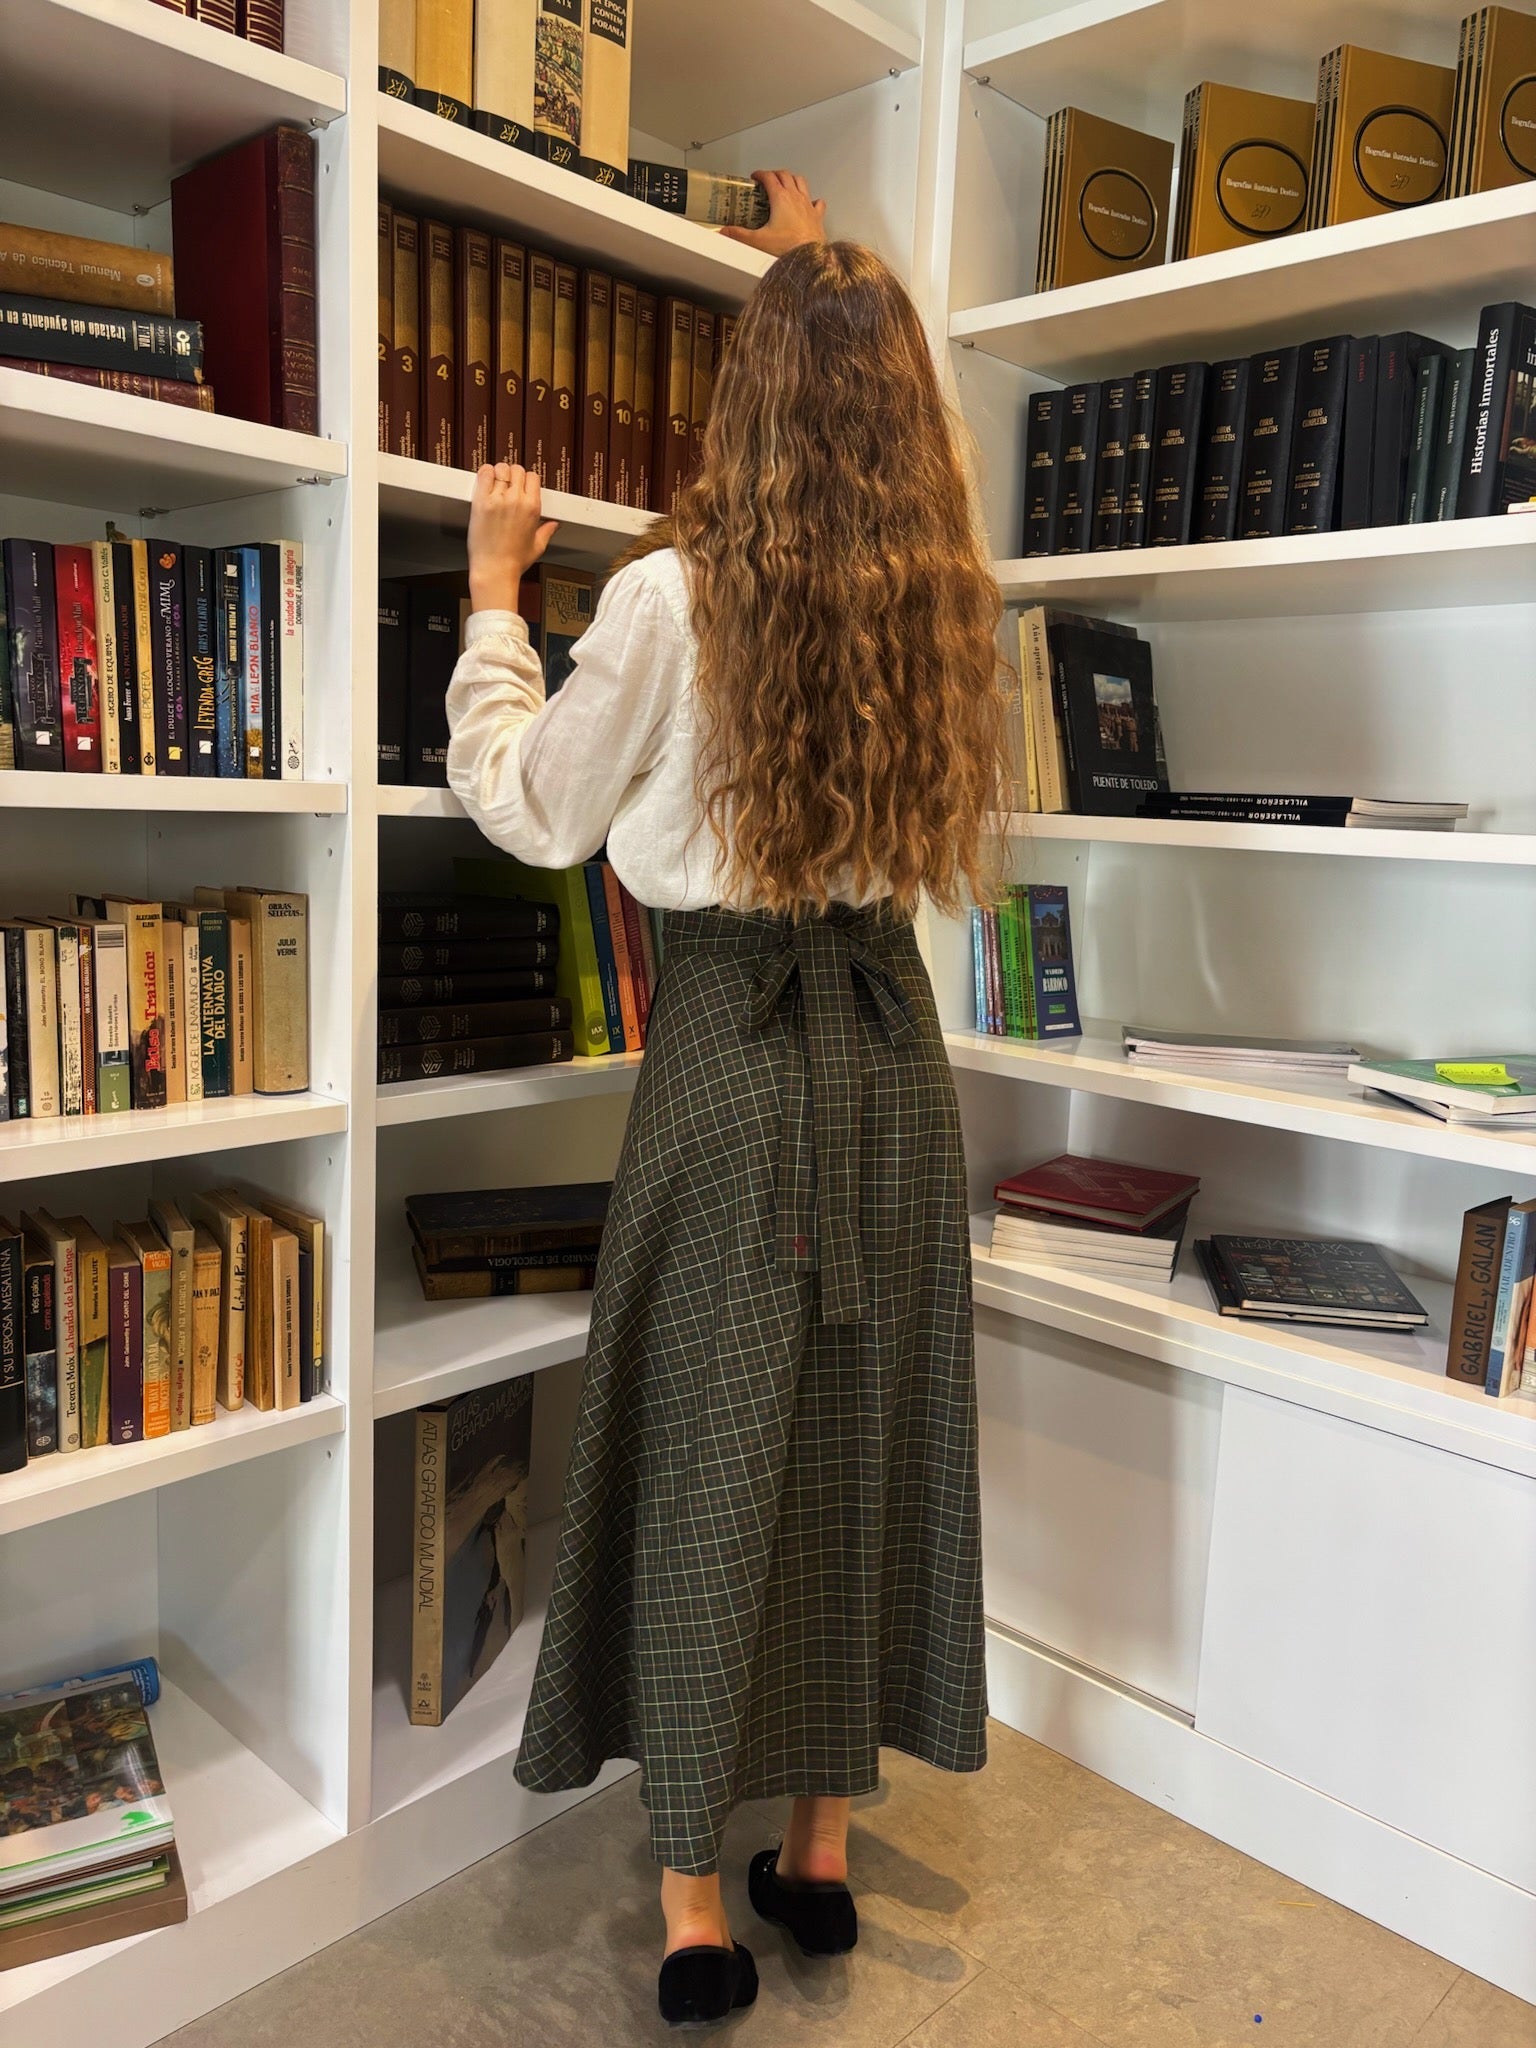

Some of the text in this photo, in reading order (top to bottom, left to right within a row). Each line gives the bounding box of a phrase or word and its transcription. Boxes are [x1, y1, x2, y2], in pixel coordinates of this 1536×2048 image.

[655, 182, 662, 192] EL
[663, 172, 671, 204] SIGLO
[671, 176, 679, 204] XVIII
[12, 253, 26, 265] de
[32, 256, 75, 276] Técnico
[80, 263, 121, 282] Manual
[6, 310, 126, 343] tratado del ayudante en
[401, 354, 413, 372] 3
[436, 364, 449, 380] 4
[474, 369, 486, 386] 5
[506, 378, 517, 395] 6
[535, 385, 546, 401] 7
[559, 394, 569, 410] 8
[1470, 328, 1500, 475] Historias inmortales
[593, 400, 603, 416] 9
[616, 408, 631, 425] 10
[637, 417, 650, 433] 11
[672, 420, 687, 437] 12
[103, 578, 111, 603] Carlos
[159, 579, 175, 618] MIMI
[284, 588, 294, 598] de
[284, 601, 295, 626] ciudad
[295, 594, 303, 625] DOMINIQUE
[196, 597, 209, 654] CHRIS RYLANDER
[248, 605, 259, 651] BLANCO
[284, 629, 295, 637] la
[121, 604, 131, 679] UN PACTO DE AMOR
[165, 625, 173, 658] VERANO
[1031, 623, 1043, 682] Aún aprendo
[35, 662, 46, 714] REINOS
[76, 664, 87, 715] REINOS
[107, 673, 114, 685] DE
[141, 669, 151, 710] PROFETA
[165, 658, 174, 696] ALOCADO
[123, 688, 133, 722] Anna Ferrer
[192, 655, 215, 730] LEYENDA GREG
[250, 693, 260, 714] MIA
[167, 703, 175, 730] DULCE
[1093, 775, 1159, 791] PUENTE DE TOLEDO
[1256, 797, 1309, 807] VILLASEÑOR
[1248, 812, 1301, 821] VILLASEÑOR
[268, 910, 301, 918] SELECTAS
[277, 938, 297, 947] JULIO
[277, 948, 297, 956] VERNE
[144, 951, 161, 1072] Falso Traidor
[202, 955, 215, 1056] LA ALTERNATIVA
[213, 969, 226, 1039] DEL DIABLO
[188, 977, 200, 1080] MIGUEL DE UNAMUNO
[628, 1026, 635, 1034] X
[1508, 1215, 1521, 1226] 56
[1503, 1231, 1516, 1275] ADENTRO
[178, 1270, 187, 1282] UN
[1500, 1276, 1510, 1296] MAR
[30, 1275, 41, 1314] inés palou
[178, 1284, 187, 1315] TURISTA
[1, 1247, 14, 1384] Y SU ESPOSA MESALINA
[177, 1317, 186, 1328] EN
[63, 1248, 77, 1417] Terenci Moix La herida de la Esfinge
[1461, 1303, 1488, 1377] GABRIEL
[175, 1367, 185, 1416] Evelyn Waugh
[418, 1419, 437, 1614] ATLAS GRAFICO MUNDIAL
